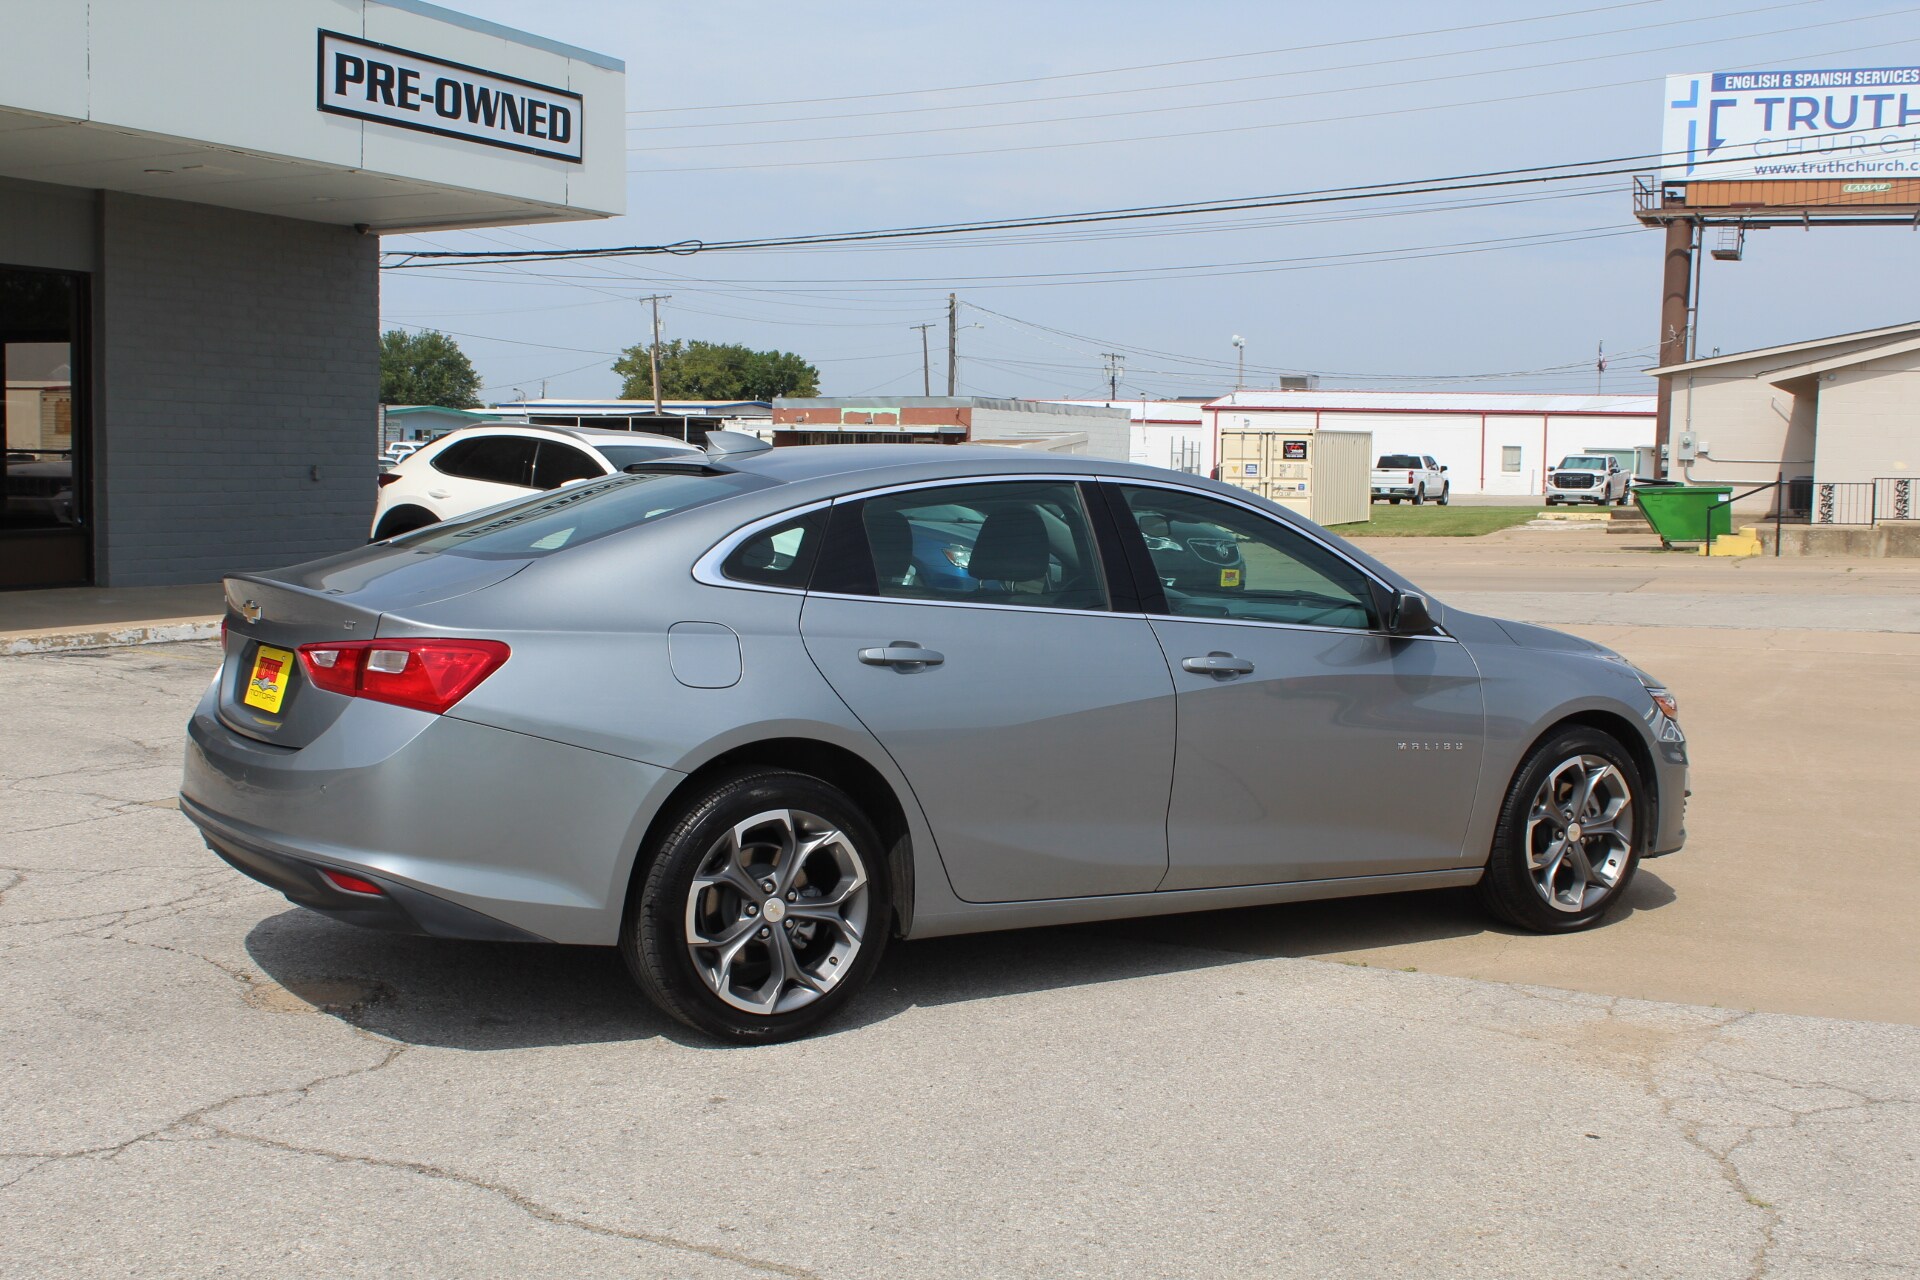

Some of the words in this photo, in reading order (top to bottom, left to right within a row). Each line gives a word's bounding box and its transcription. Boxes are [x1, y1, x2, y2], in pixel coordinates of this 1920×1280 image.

[1725, 74, 1779, 89] ENGLISH
[1782, 74, 1792, 87] &
[1795, 72, 1851, 86] SPANISH
[1854, 69, 1919, 85] SERVICES
[335, 52, 571, 144] PRE-OWNED
[1754, 93, 1920, 132] TRUTH
[1397, 742, 1463, 750] MALIBU
